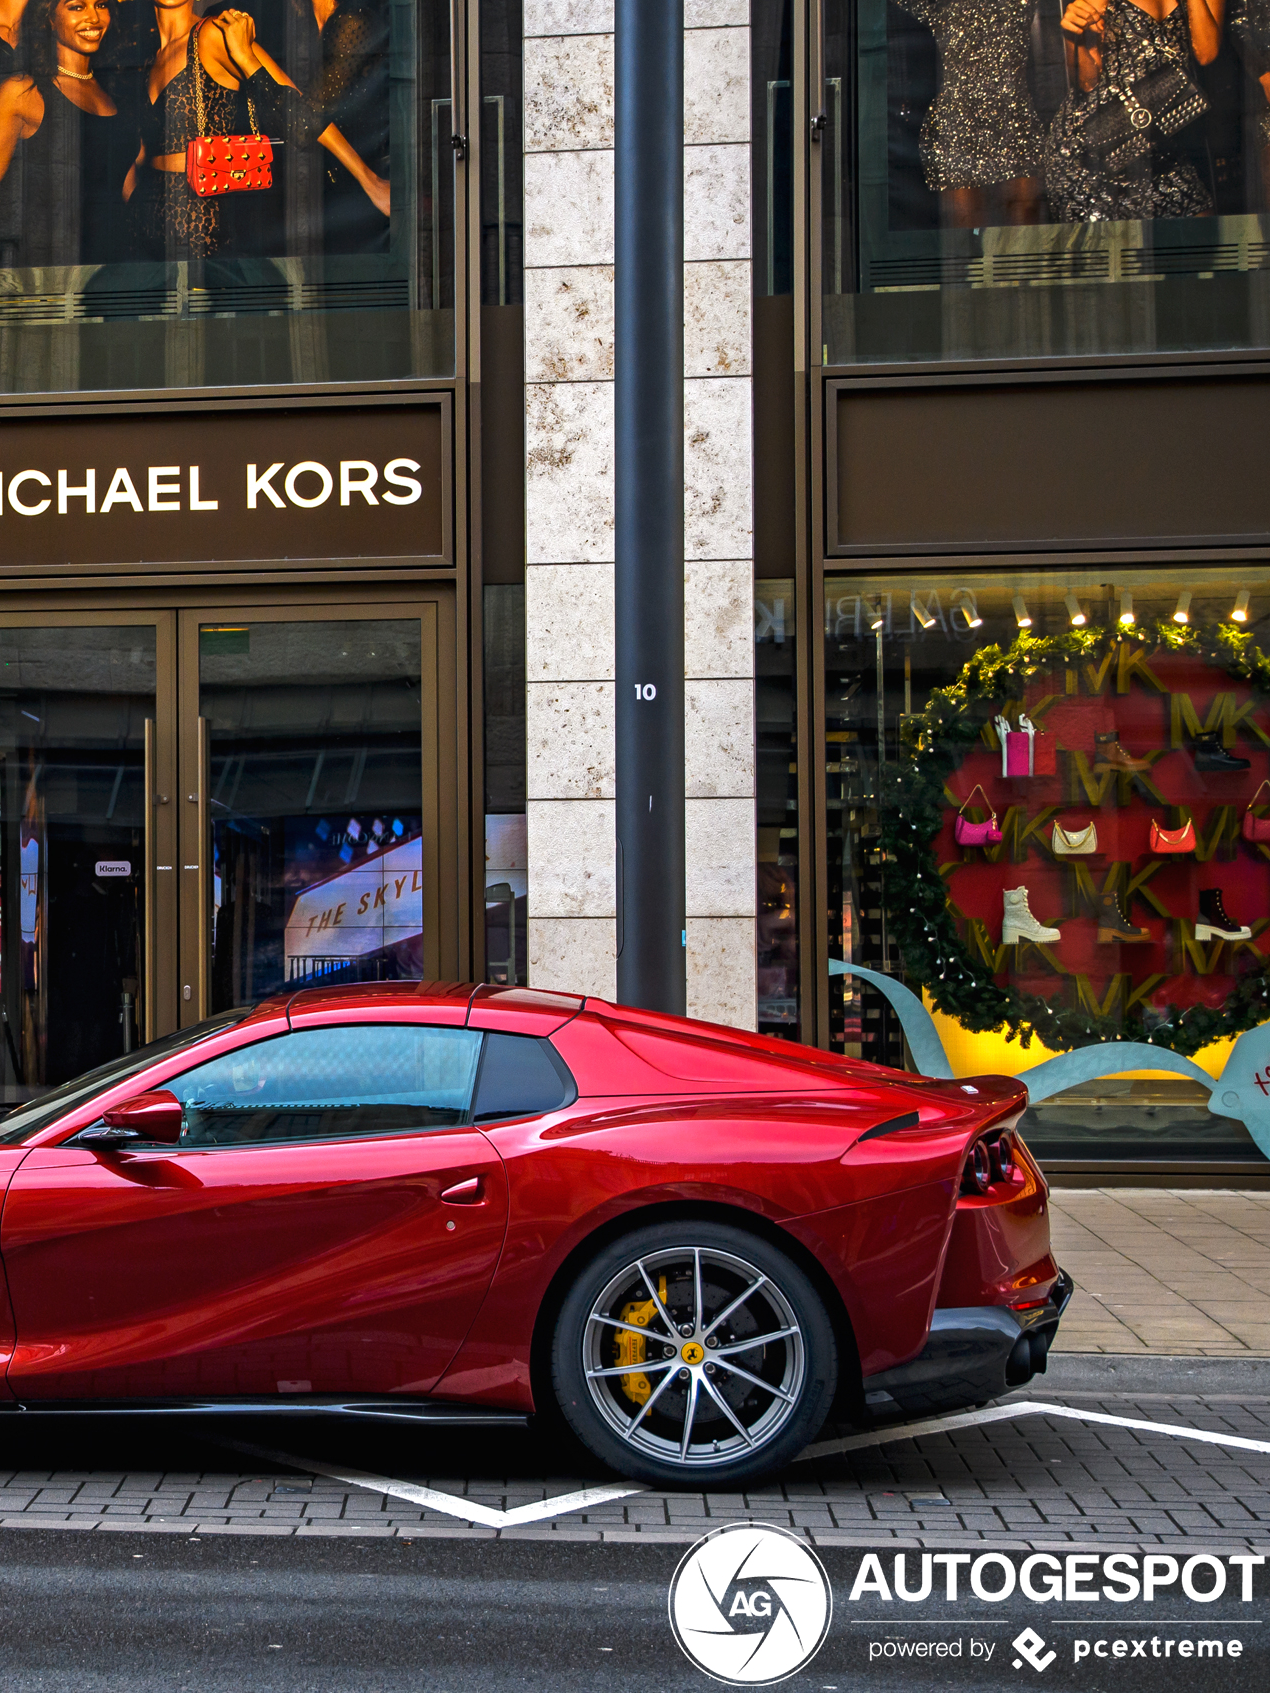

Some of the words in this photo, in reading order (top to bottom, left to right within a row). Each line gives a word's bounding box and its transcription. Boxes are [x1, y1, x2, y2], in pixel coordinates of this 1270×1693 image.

[246, 458, 423, 509] KORS
[634, 683, 657, 701] 10
[99, 865, 128, 873] Klarna.
[305, 902, 347, 937] THE
[357, 871, 423, 916] SKYL
